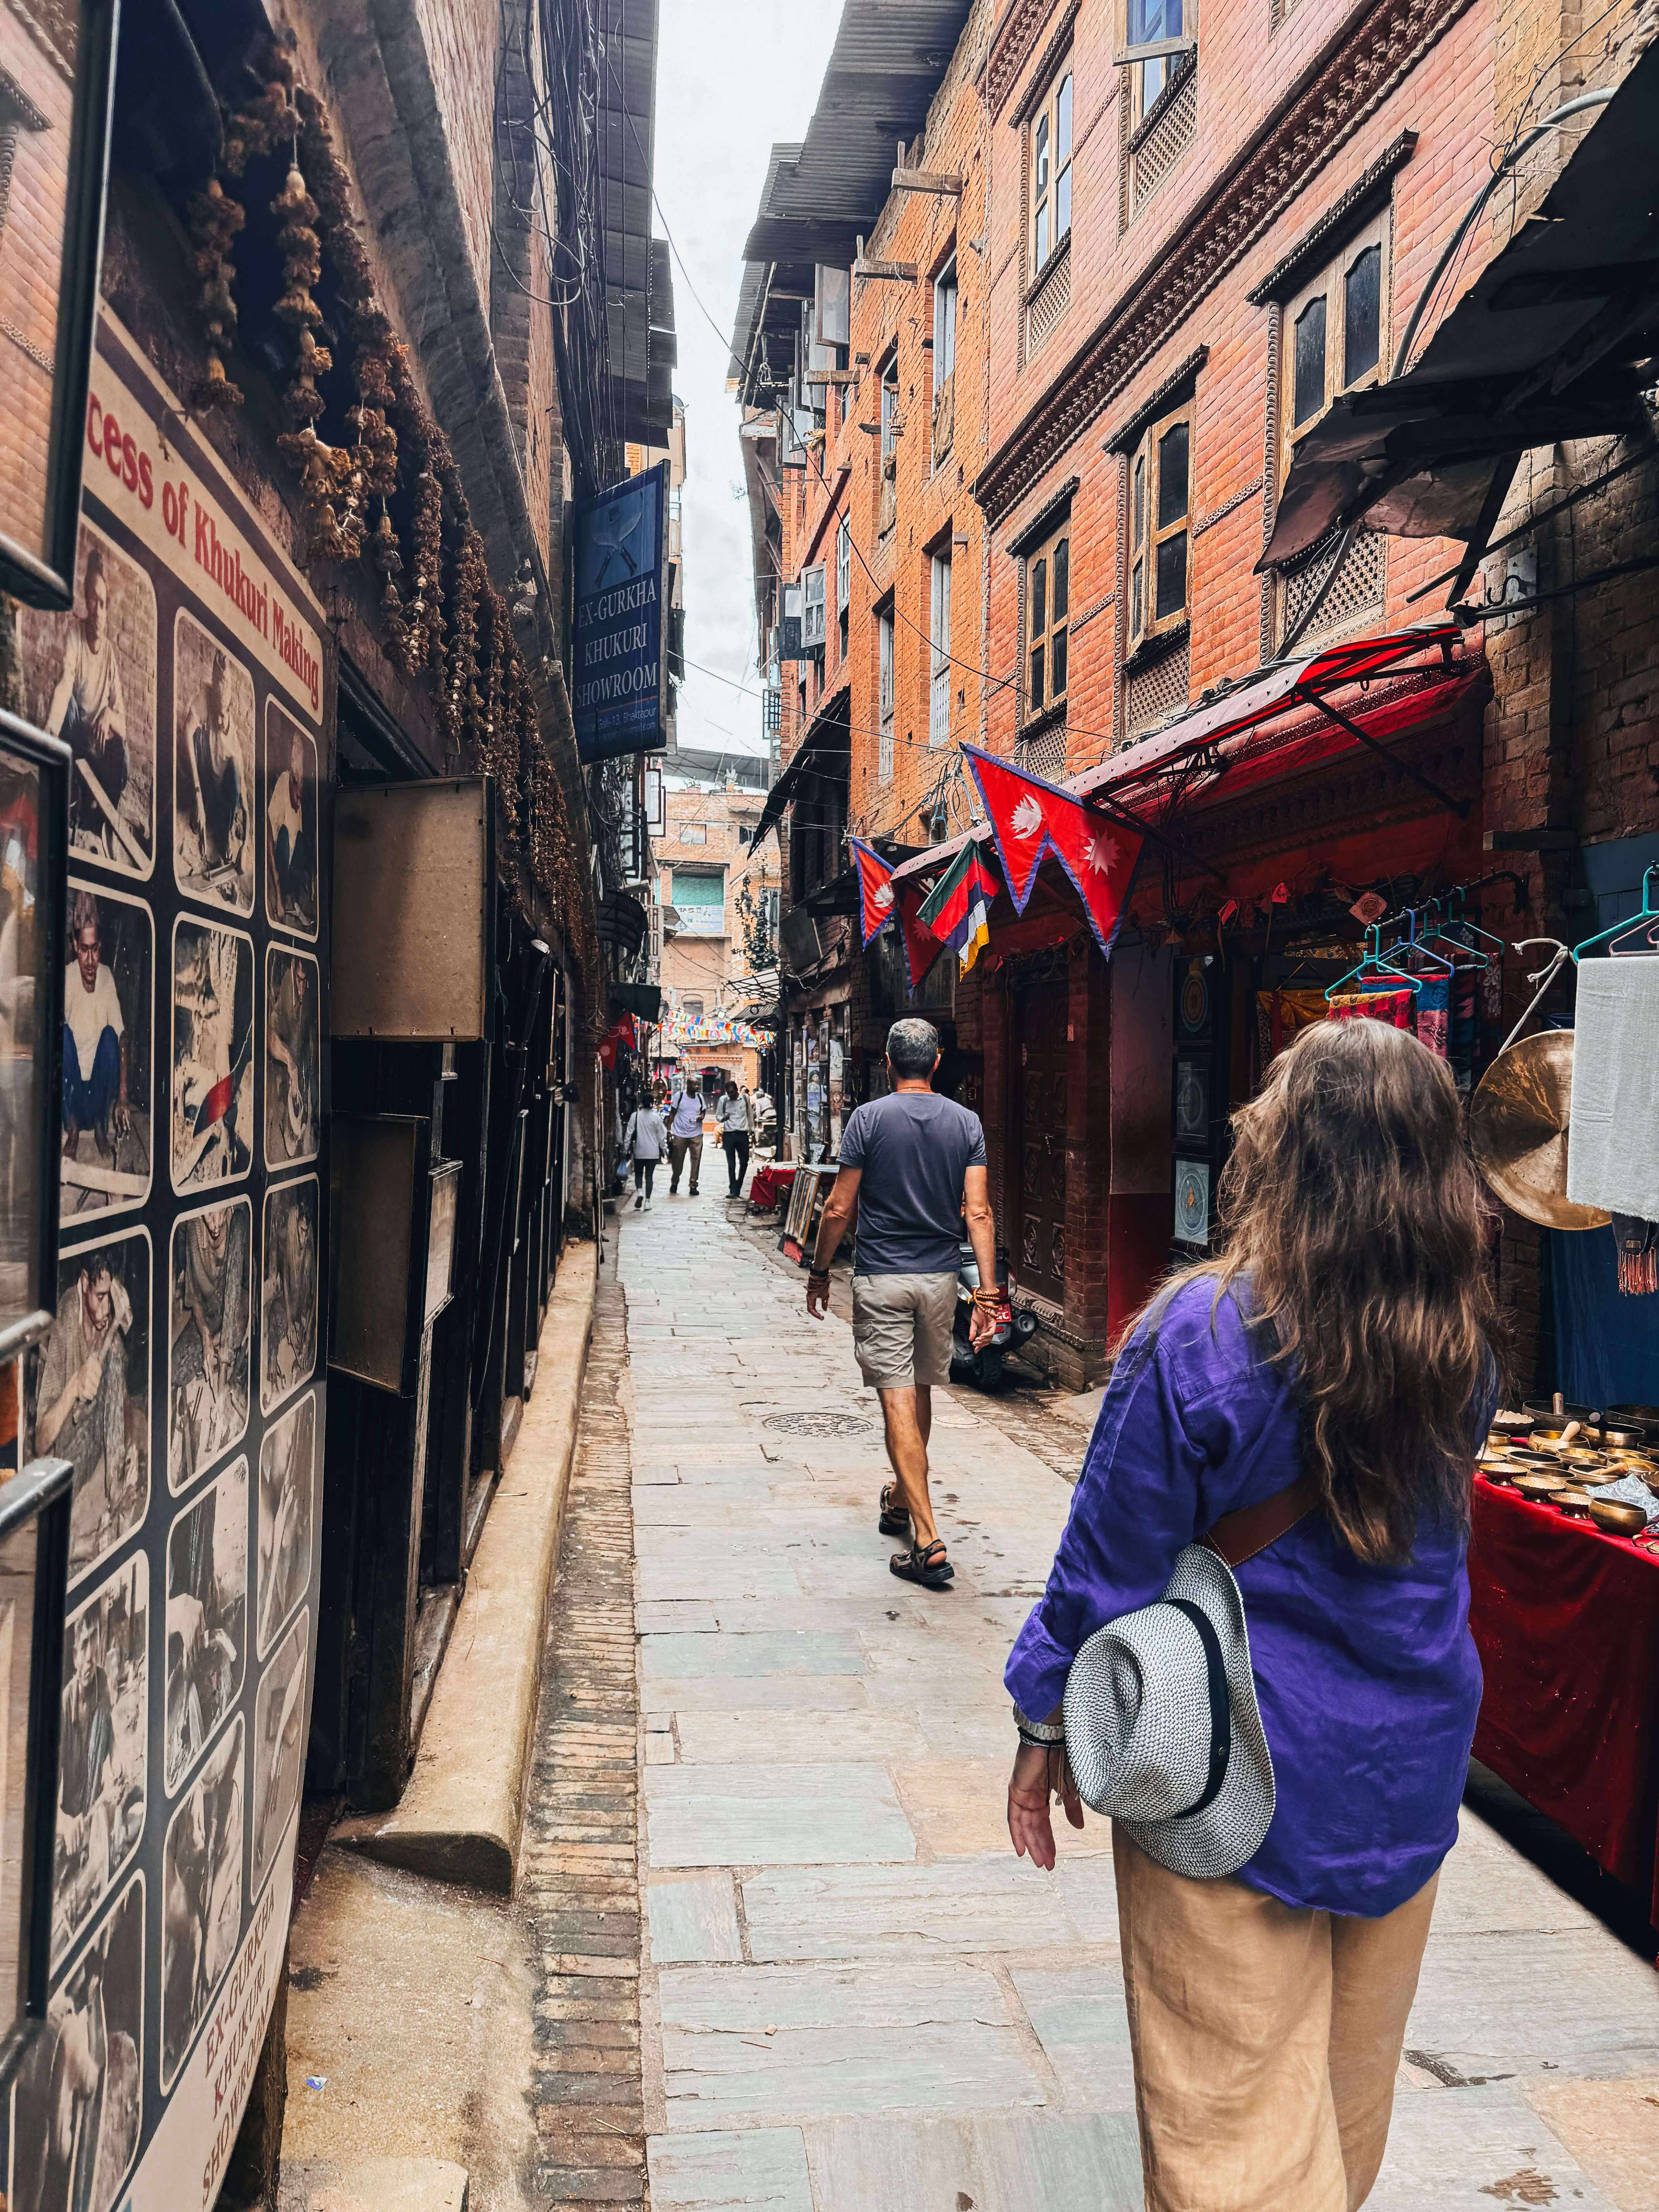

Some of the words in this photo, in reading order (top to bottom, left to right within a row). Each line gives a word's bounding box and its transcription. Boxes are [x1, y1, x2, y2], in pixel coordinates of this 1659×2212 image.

[162, 481, 189, 549] of
[194, 499, 268, 641] Khukuri
[273, 597, 318, 711] Making
[578, 578, 657, 629] EX-GURKHA
[584, 623, 647, 666] KHUKURI
[576, 662, 657, 708] SHOWROOM
[623, 707, 657, 723] Bhaktapur
[205, 1883, 274, 2078] EX-GURKHA
[213, 1950, 266, 2121] KHUKURI
